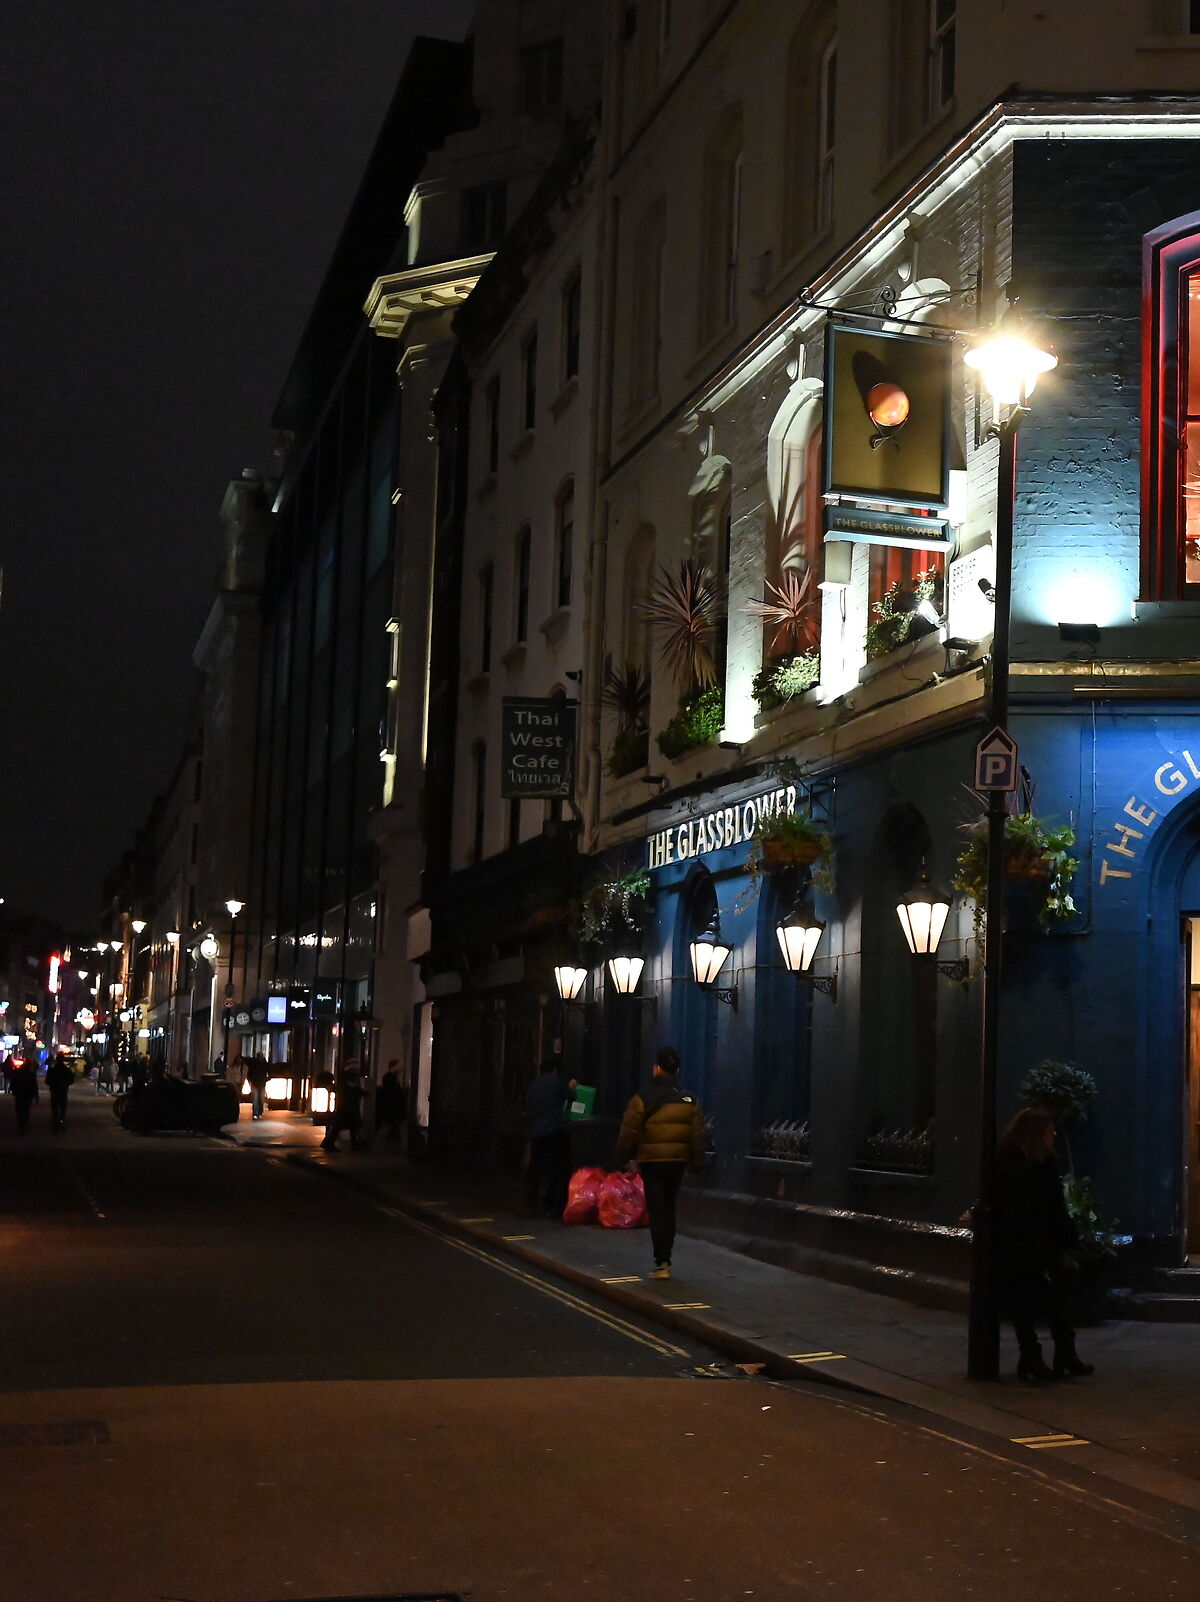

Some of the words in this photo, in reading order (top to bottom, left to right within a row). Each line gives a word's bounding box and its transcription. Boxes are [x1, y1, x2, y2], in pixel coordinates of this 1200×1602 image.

[835, 517, 857, 528] THE
[861, 521, 940, 538] GLASSBLOWER
[513, 711, 560, 725] Thai
[510, 732, 564, 748] West
[512, 754, 560, 768] Cafe
[985, 756, 1006, 784] P
[647, 828, 674, 870] THE
[677, 785, 797, 861] GLASSBLOWER
[1099, 796, 1160, 886] THE
